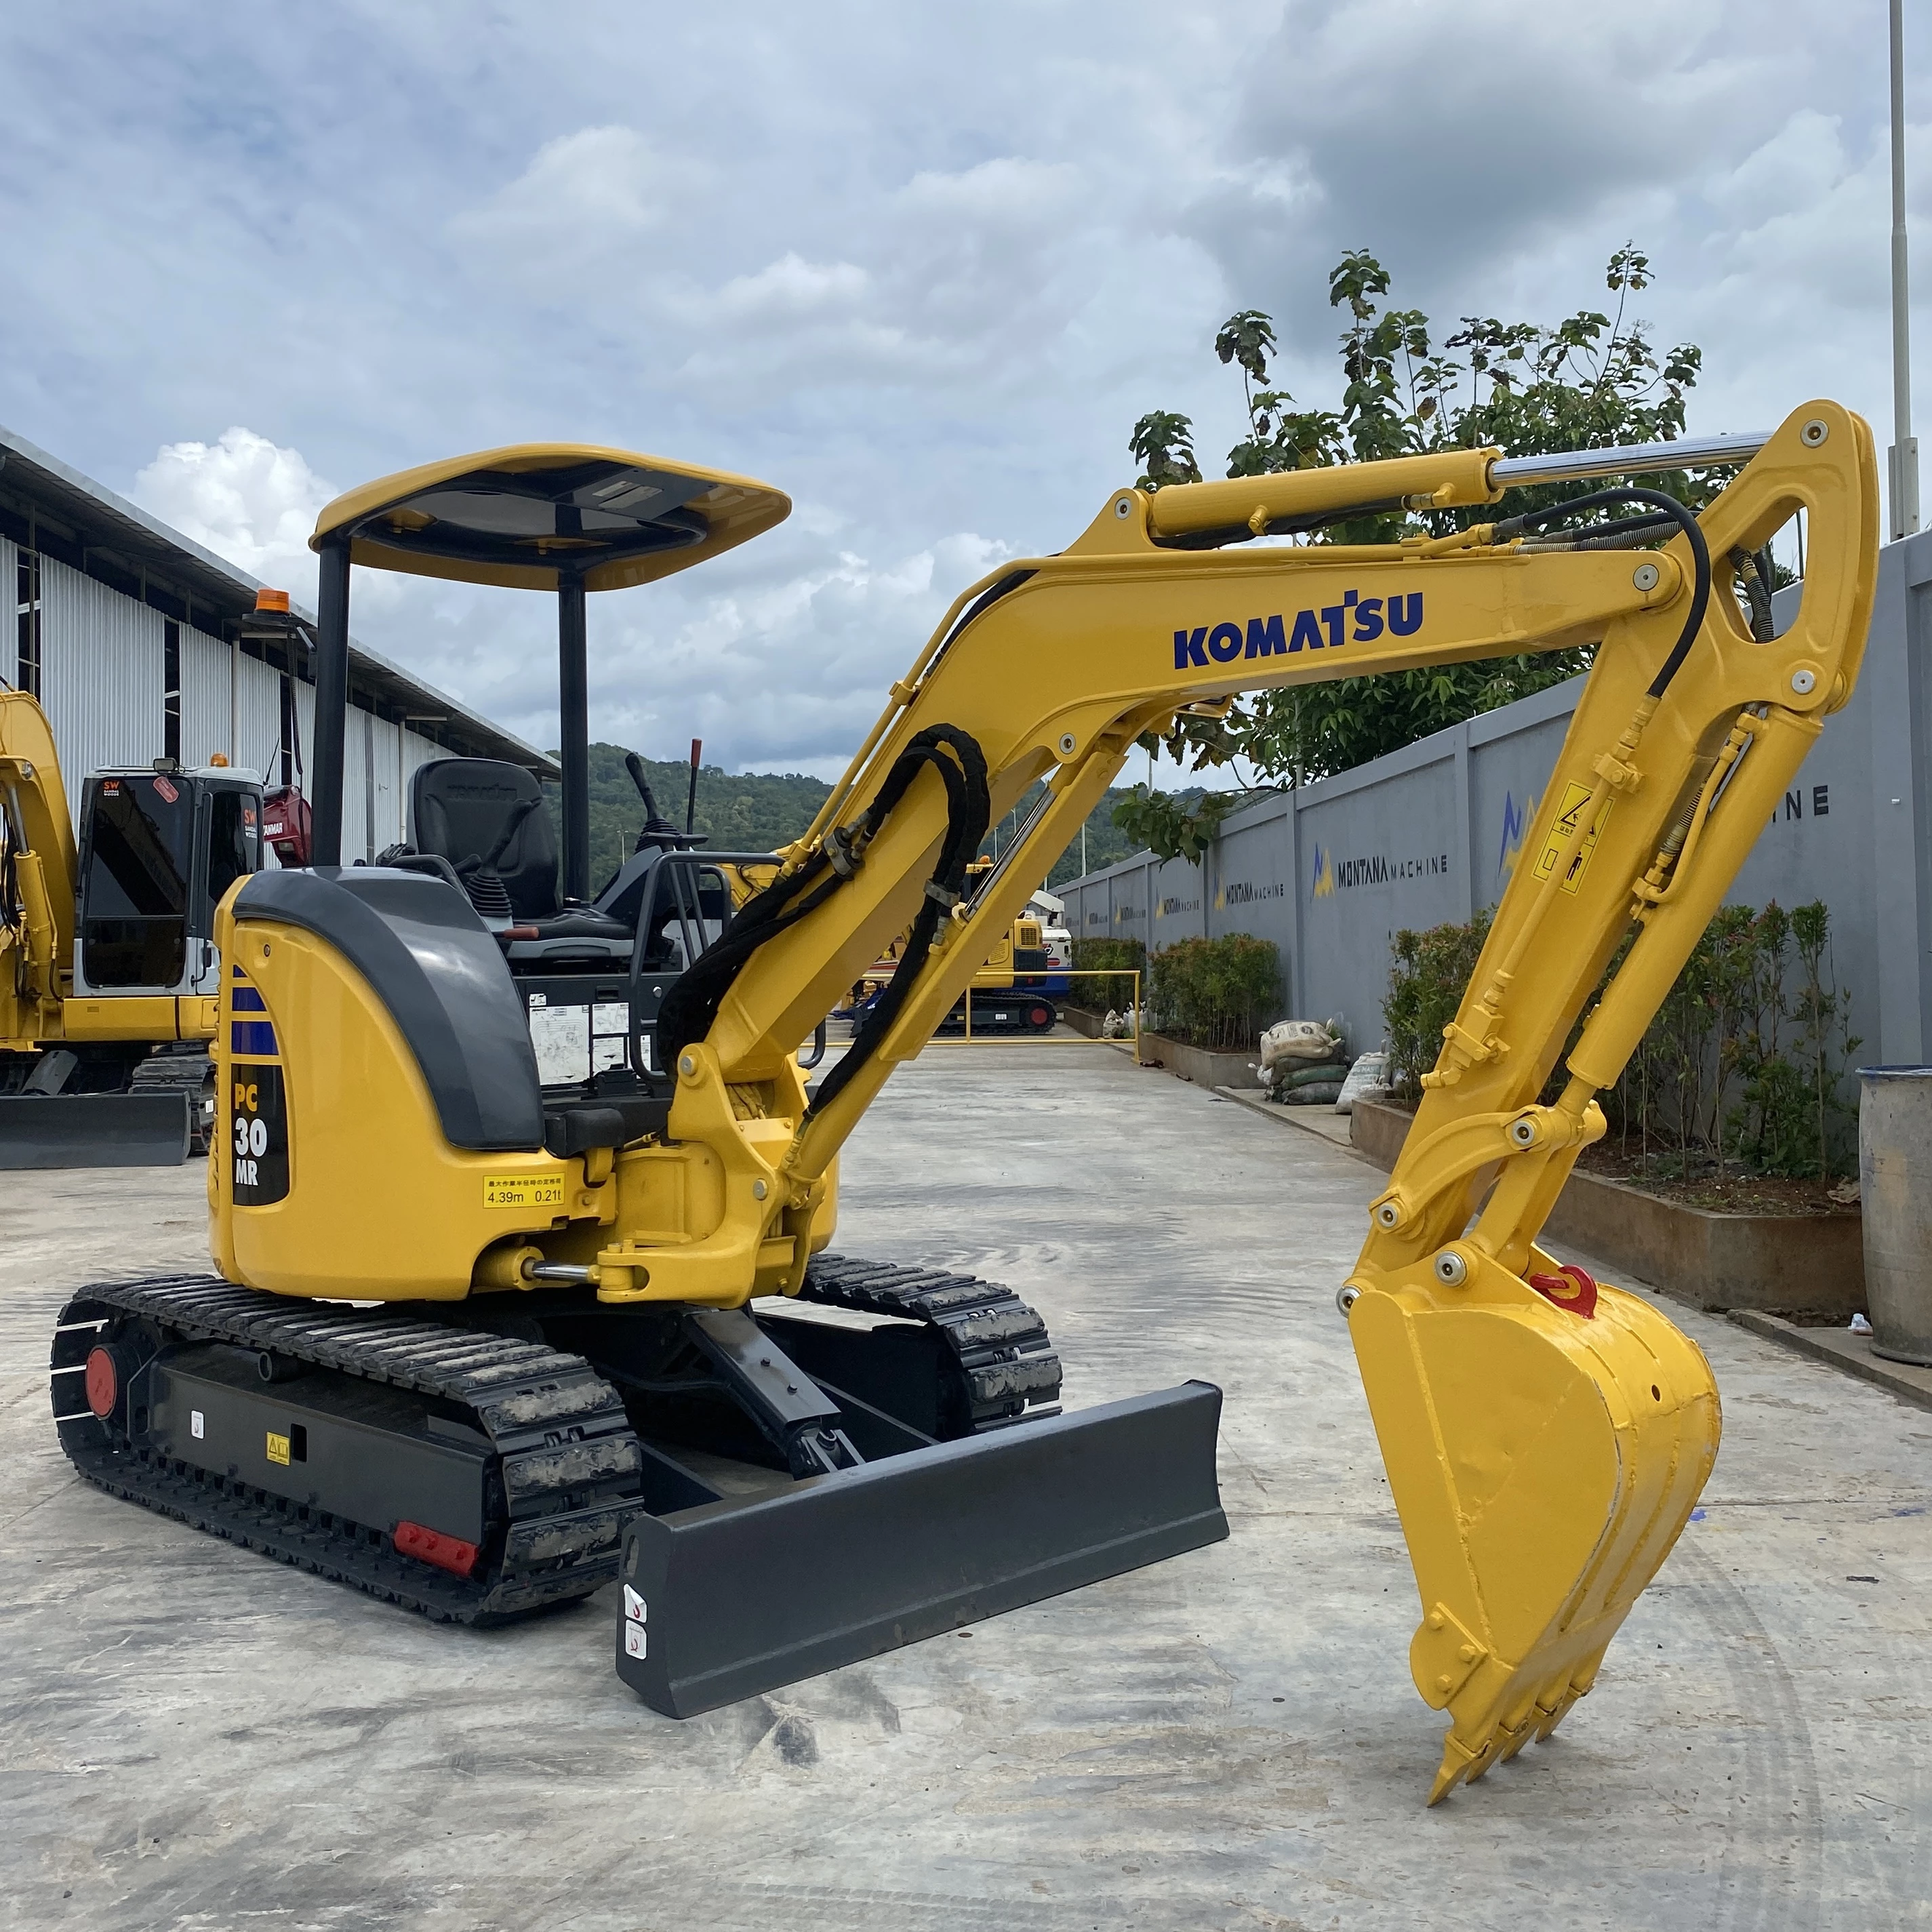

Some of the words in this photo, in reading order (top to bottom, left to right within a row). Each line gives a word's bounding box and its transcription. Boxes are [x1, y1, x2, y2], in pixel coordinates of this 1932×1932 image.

[1173, 589, 1423, 670] KOMATSU
[104, 781, 119, 790] SW
[245, 809, 256, 824] SW
[1338, 856, 1389, 889] MONTANA
[1390, 854, 1447, 881] MACHINE
[1226, 881, 1253, 905] MONTANA
[235, 1083, 258, 1112] PC
[235, 1117, 268, 1157] 30
[235, 1159, 258, 1186] MR
[487, 1191, 524, 1203] 4.39m
[535, 1189, 561, 1202] 0.21t
